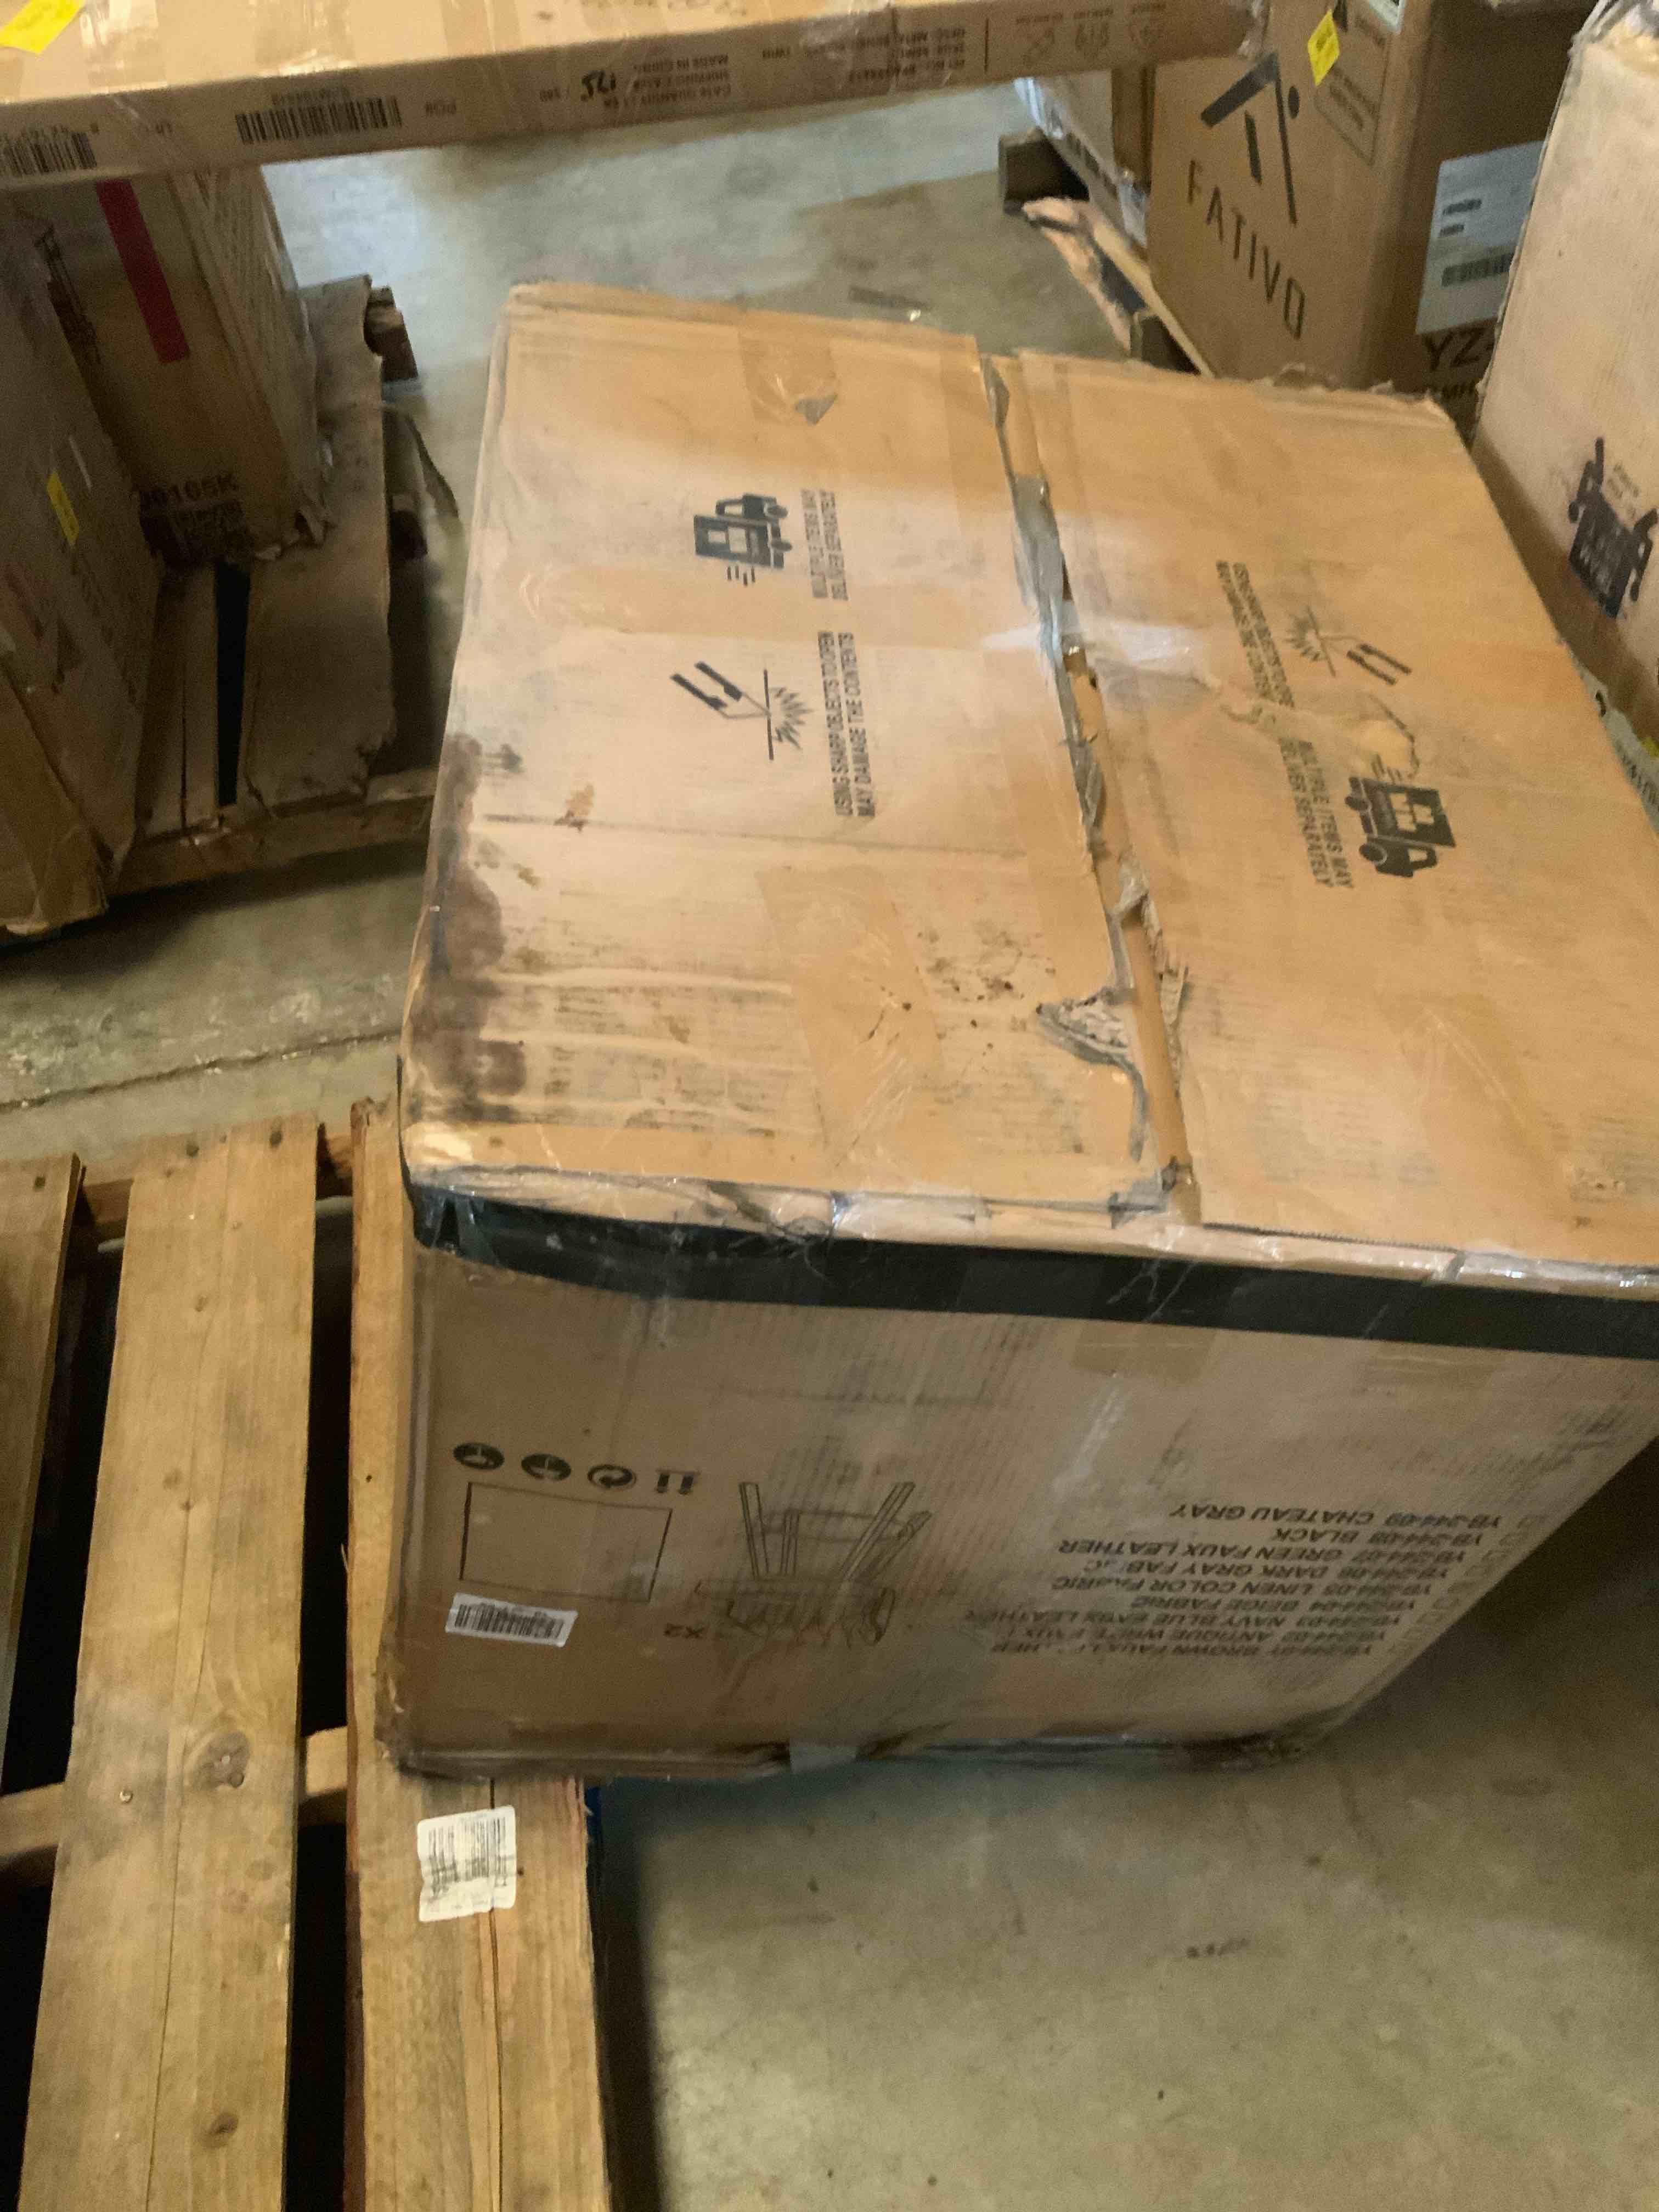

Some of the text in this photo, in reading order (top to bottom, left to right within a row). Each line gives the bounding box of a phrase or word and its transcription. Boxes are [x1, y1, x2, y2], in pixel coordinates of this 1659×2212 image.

[1187, 159, 1306, 340] FATIVO
[1169, 1504, 1246, 1521] GRAY
[1250, 1506, 1375, 1525] CHATEAU
[1270, 1527, 1359, 1544] BLACK
[1058, 1539, 1179, 1556] LEATHER
[1182, 1542, 1253, 1560] FAUX
[1255, 1546, 1343, 1561] GREEN
[1084, 1559, 1178, 1575] FABIC
[1182, 1562, 1253, 1577] GRAY
[1262, 1565, 1329, 1579] DARK
[1149, 1579, 1237, 1594] COLOR
[1240, 1581, 1314, 1596] LINEN
[1130, 1595, 1222, 1611] FABRIC
[1226, 1598, 1300, 1612] BEIGE
[1152, 1613, 1218, 1626] BLUE
[1220, 1615, 1286, 1627] NAVY
[1169, 1629, 1274, 1643] ANTIQUE
[1171, 1644, 1261, 1656] BROWN
